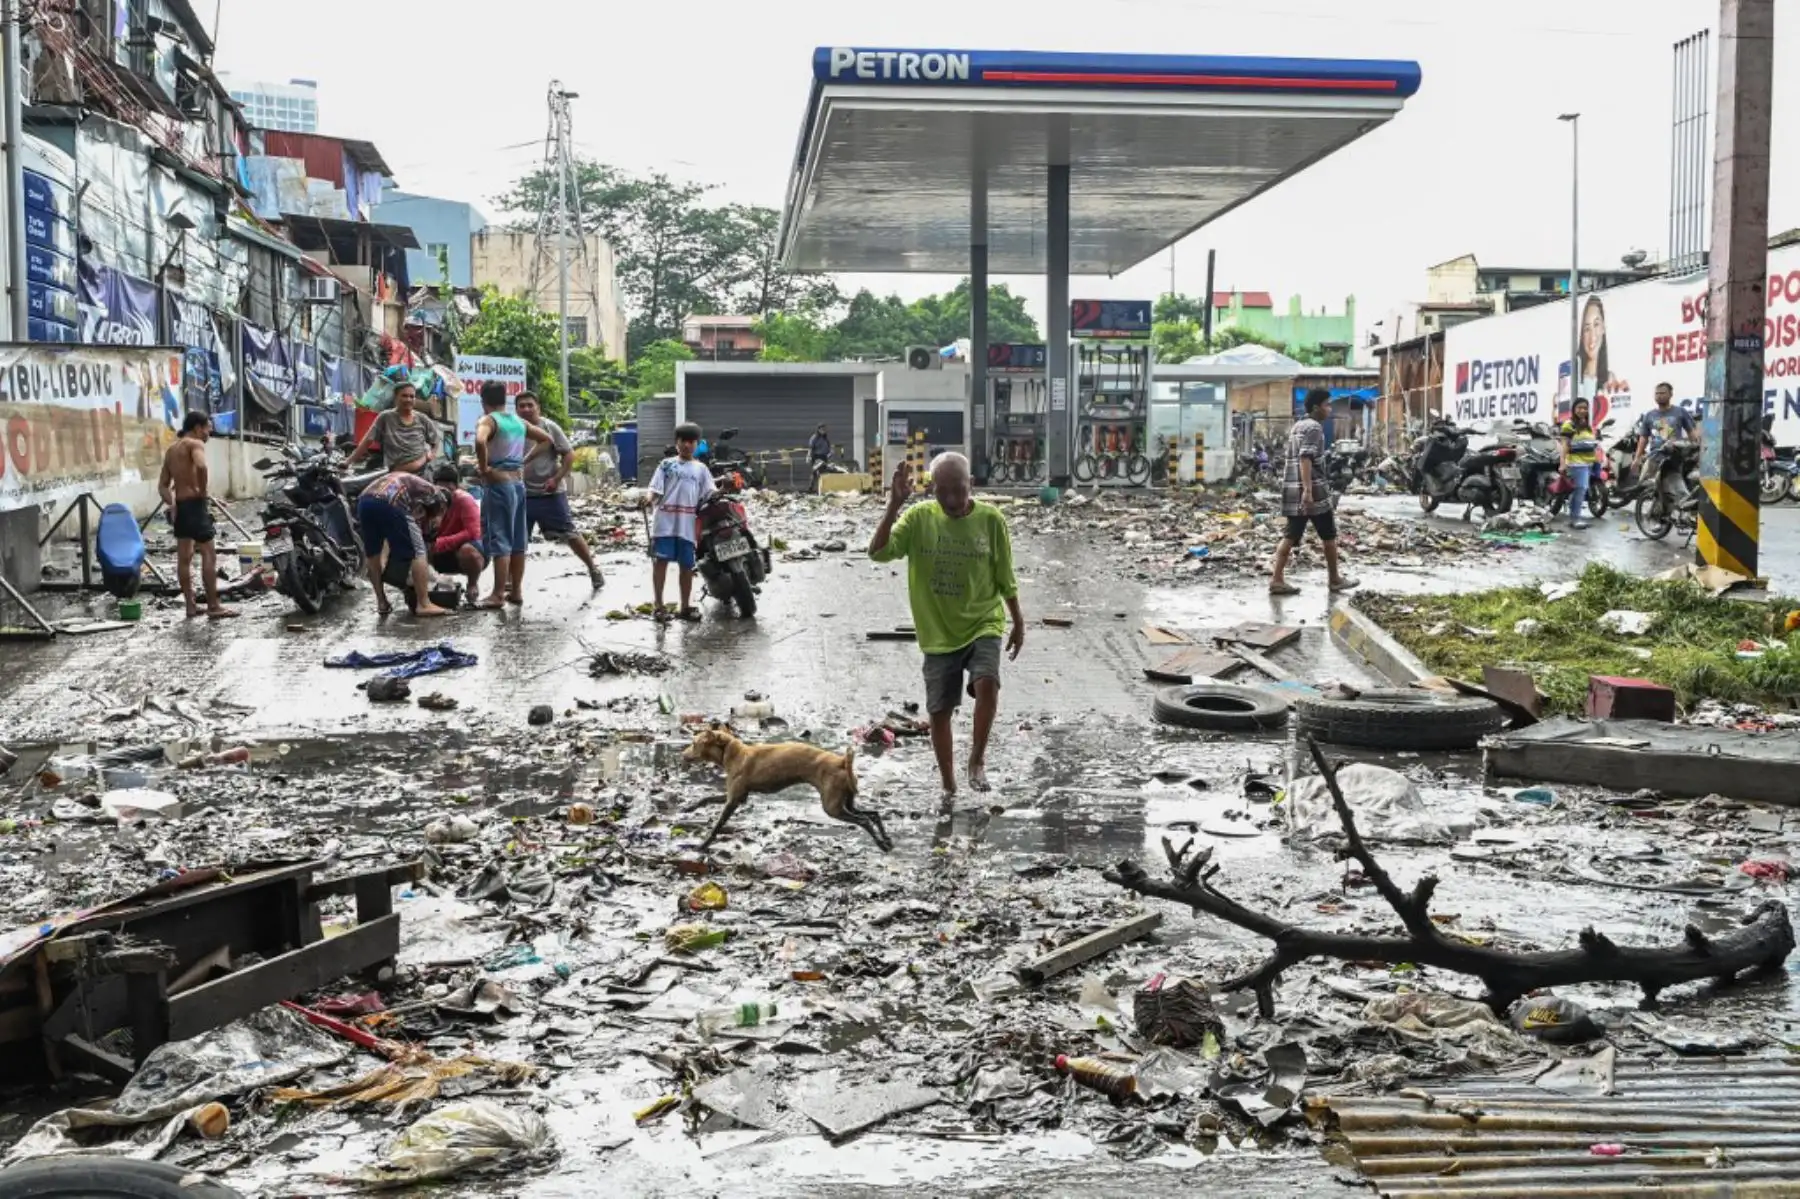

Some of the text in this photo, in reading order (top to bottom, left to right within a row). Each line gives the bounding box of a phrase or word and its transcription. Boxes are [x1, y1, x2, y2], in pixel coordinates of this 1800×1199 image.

[830, 47, 969, 80] PETRON
[1136, 309, 1144, 323] 1
[1471, 354, 1540, 392] PETRON
[1456, 391, 1538, 421] VALUE CARD
